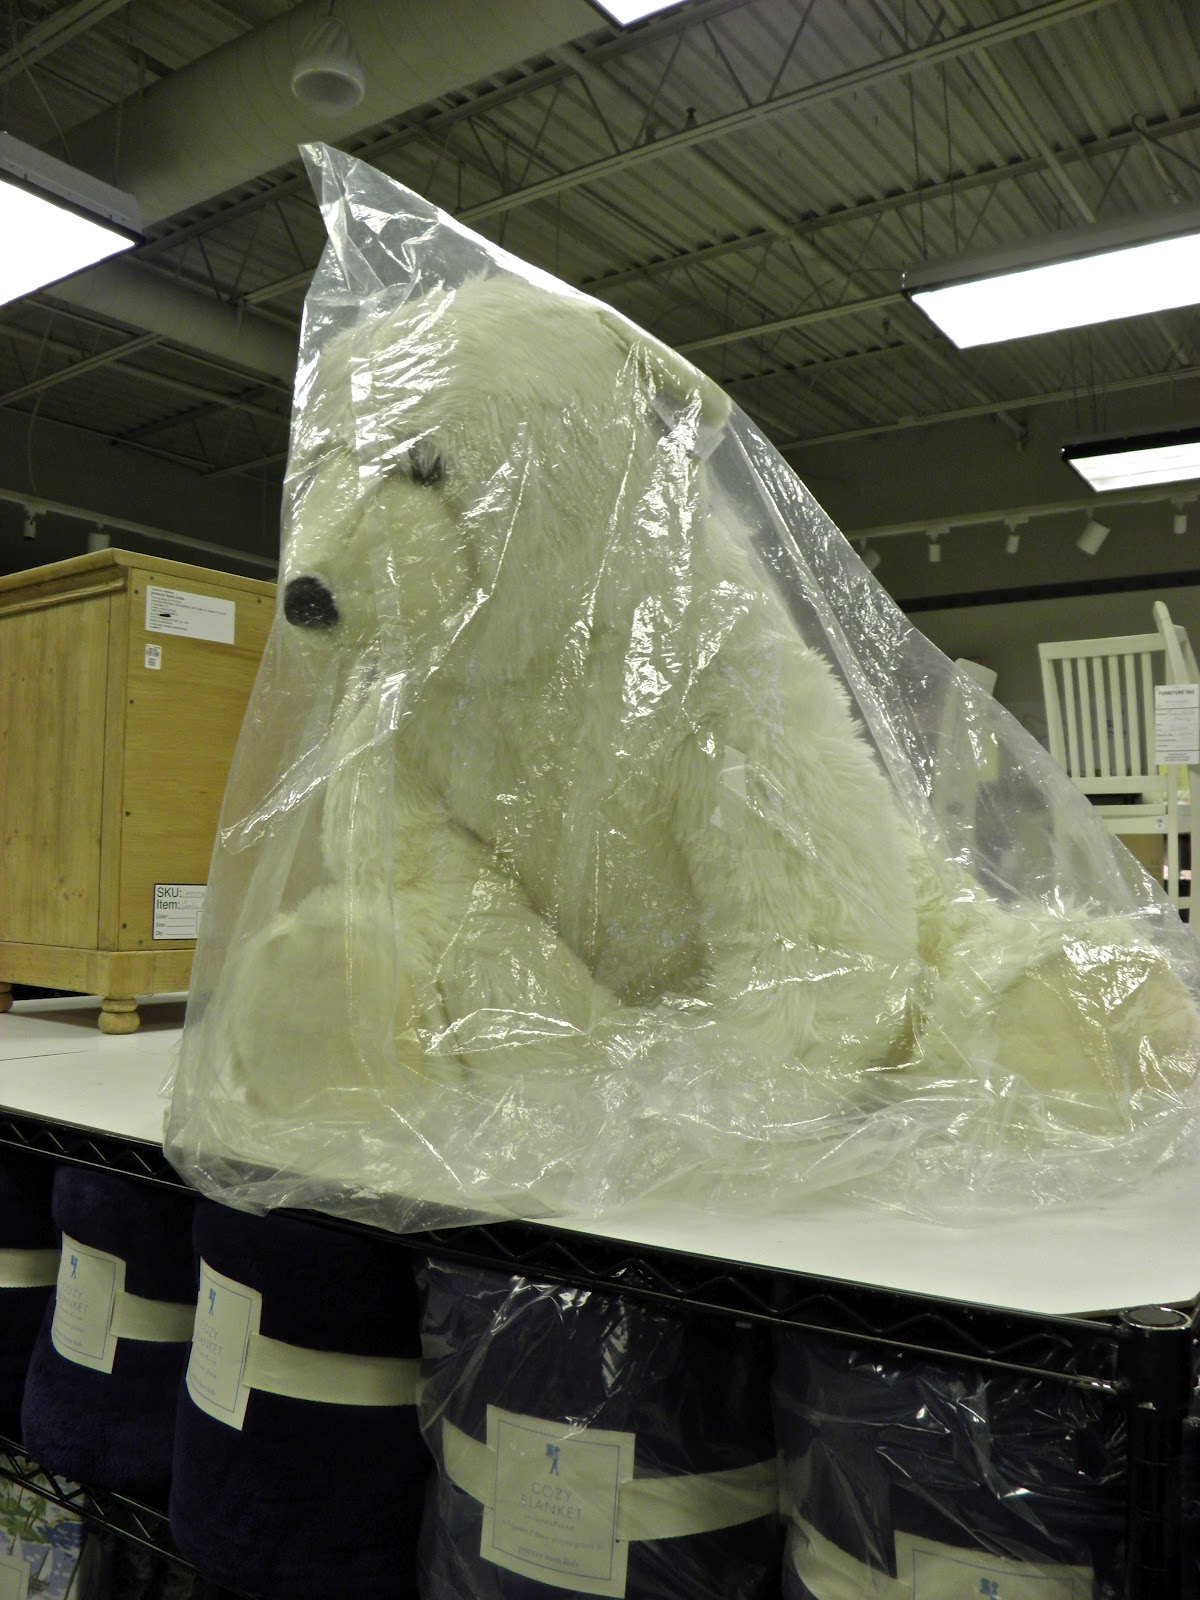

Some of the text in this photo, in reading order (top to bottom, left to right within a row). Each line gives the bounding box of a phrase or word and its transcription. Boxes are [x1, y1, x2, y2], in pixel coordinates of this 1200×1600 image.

[156, 886, 182, 898] SKU:
[156, 899, 180, 910] Item:
[62, 1282, 83, 1300] COZY
[531, 1481, 573, 1502] COZY
[521, 1494, 583, 1520] BLANKET
